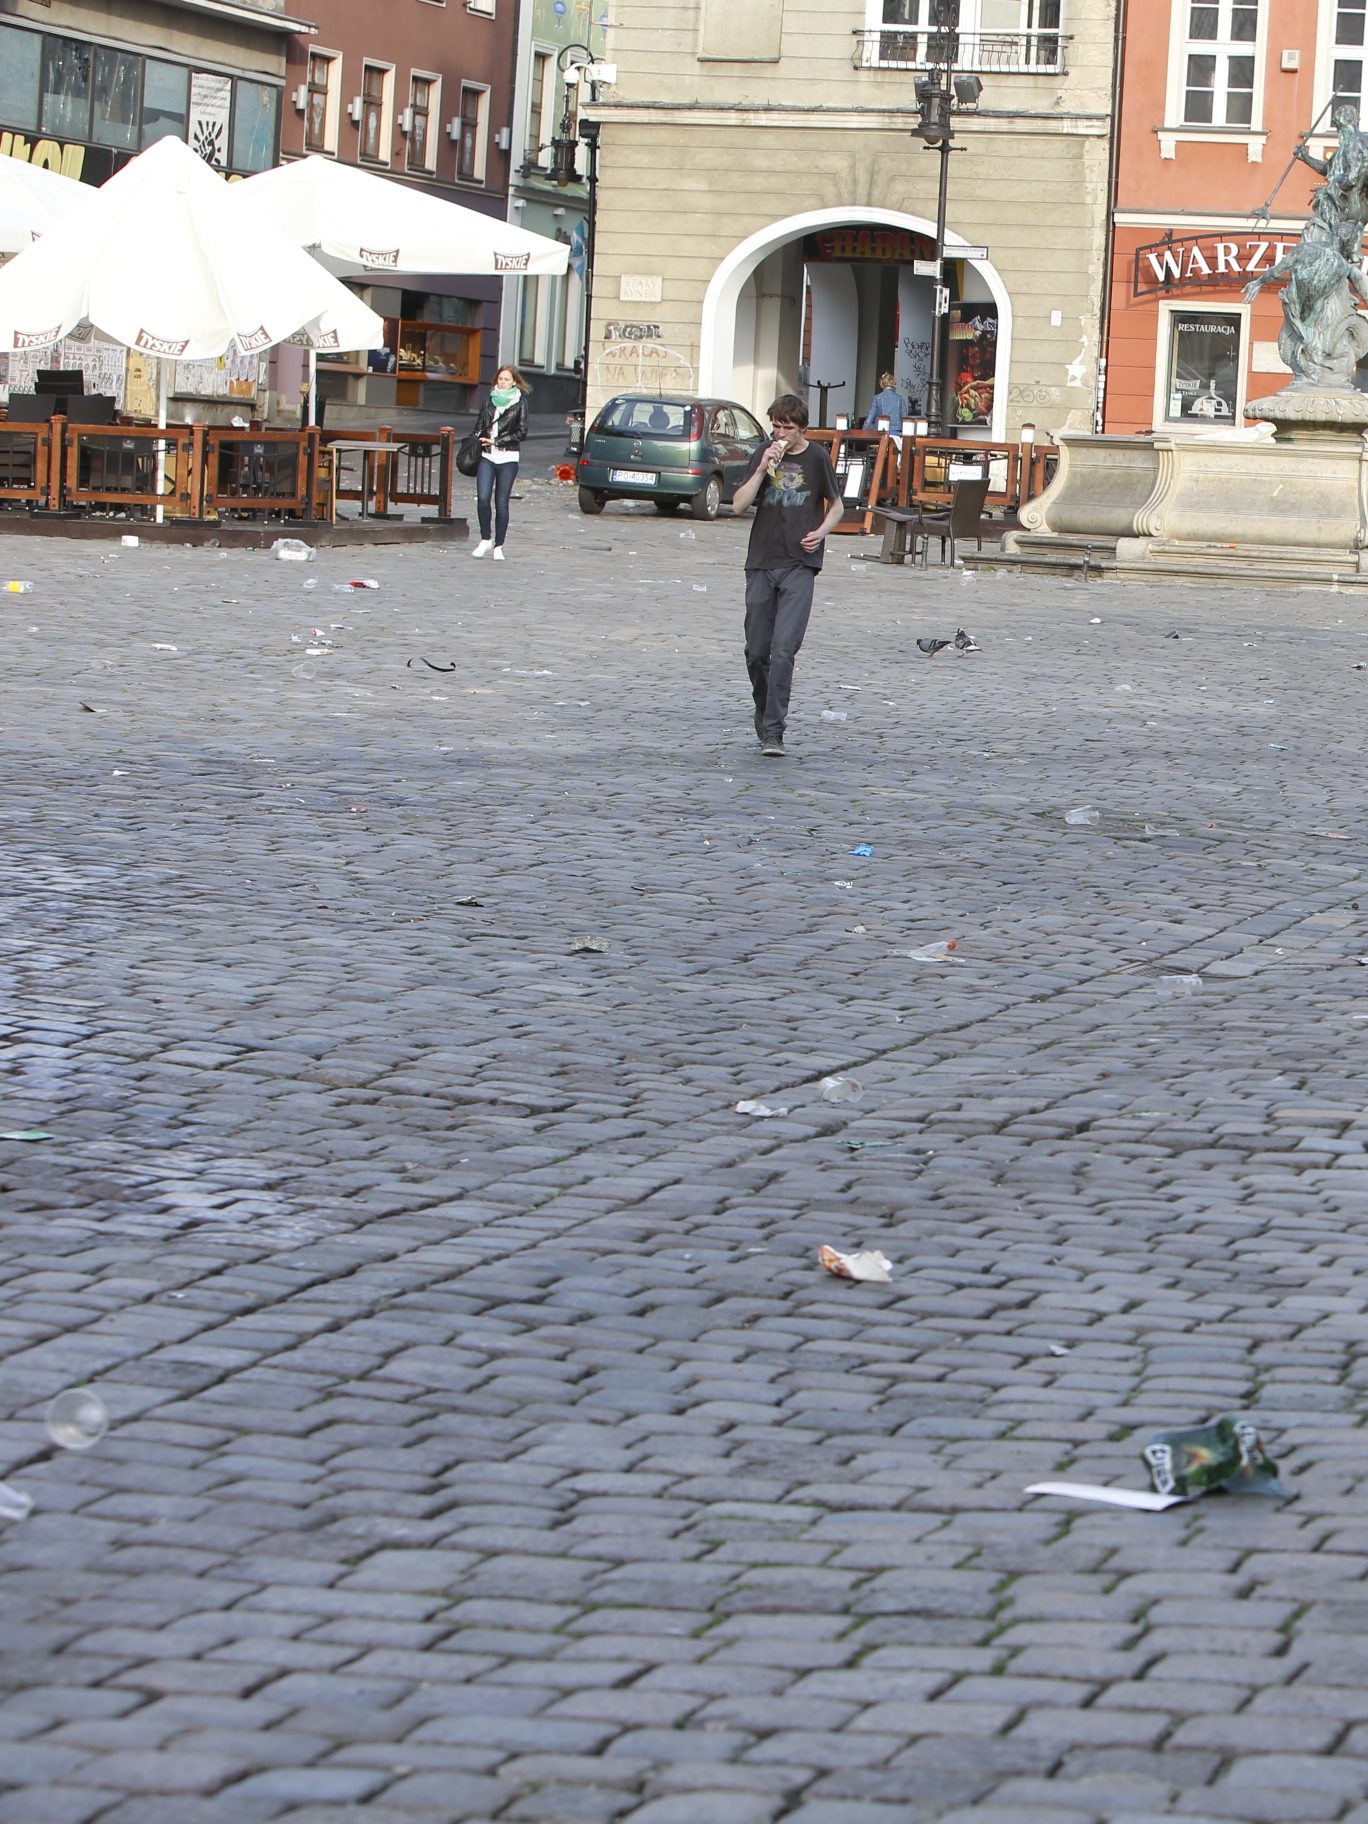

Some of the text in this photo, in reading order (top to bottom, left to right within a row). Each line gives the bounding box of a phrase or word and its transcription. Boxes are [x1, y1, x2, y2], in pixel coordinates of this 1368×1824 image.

[362, 251, 396, 267] TYSKIE
[496, 255, 528, 271] TYSKIE
[625, 279, 657, 288] STARY
[623, 289, 656, 298] RYNEK
[1178, 323, 1235, 335] RESTAURACJA
[16, 327, 59, 348] TYSKIE
[138, 331, 187, 355] TYSKIE
[1177, 381, 1199, 389] TYSKIE
